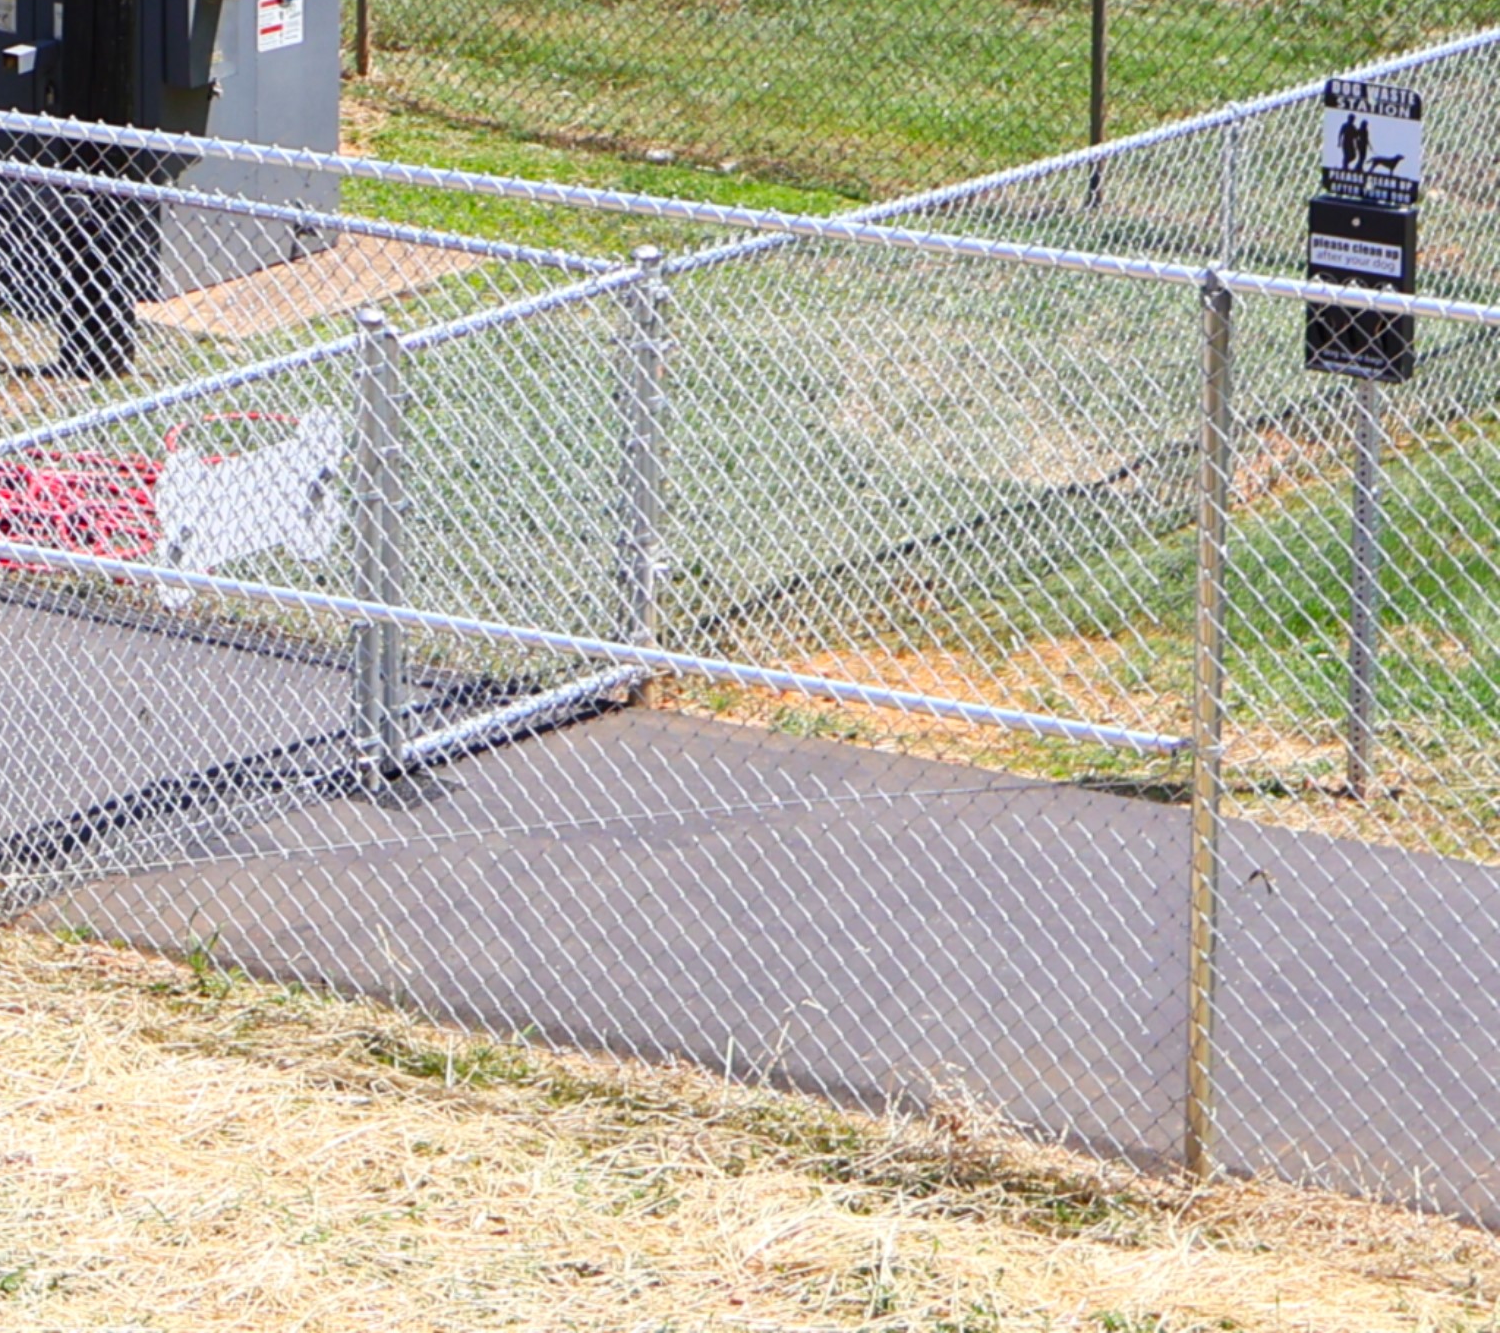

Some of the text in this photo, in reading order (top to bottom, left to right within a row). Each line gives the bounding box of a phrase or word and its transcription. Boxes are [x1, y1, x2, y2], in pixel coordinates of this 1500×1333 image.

[1331, 80, 1415, 105] DOG WASTE
[1337, 97, 1411, 118] STATION
[1329, 169, 1364, 184] PLEASE
[1313, 237, 1399, 260] please clean up
[1317, 250, 1395, 273] after your dog
